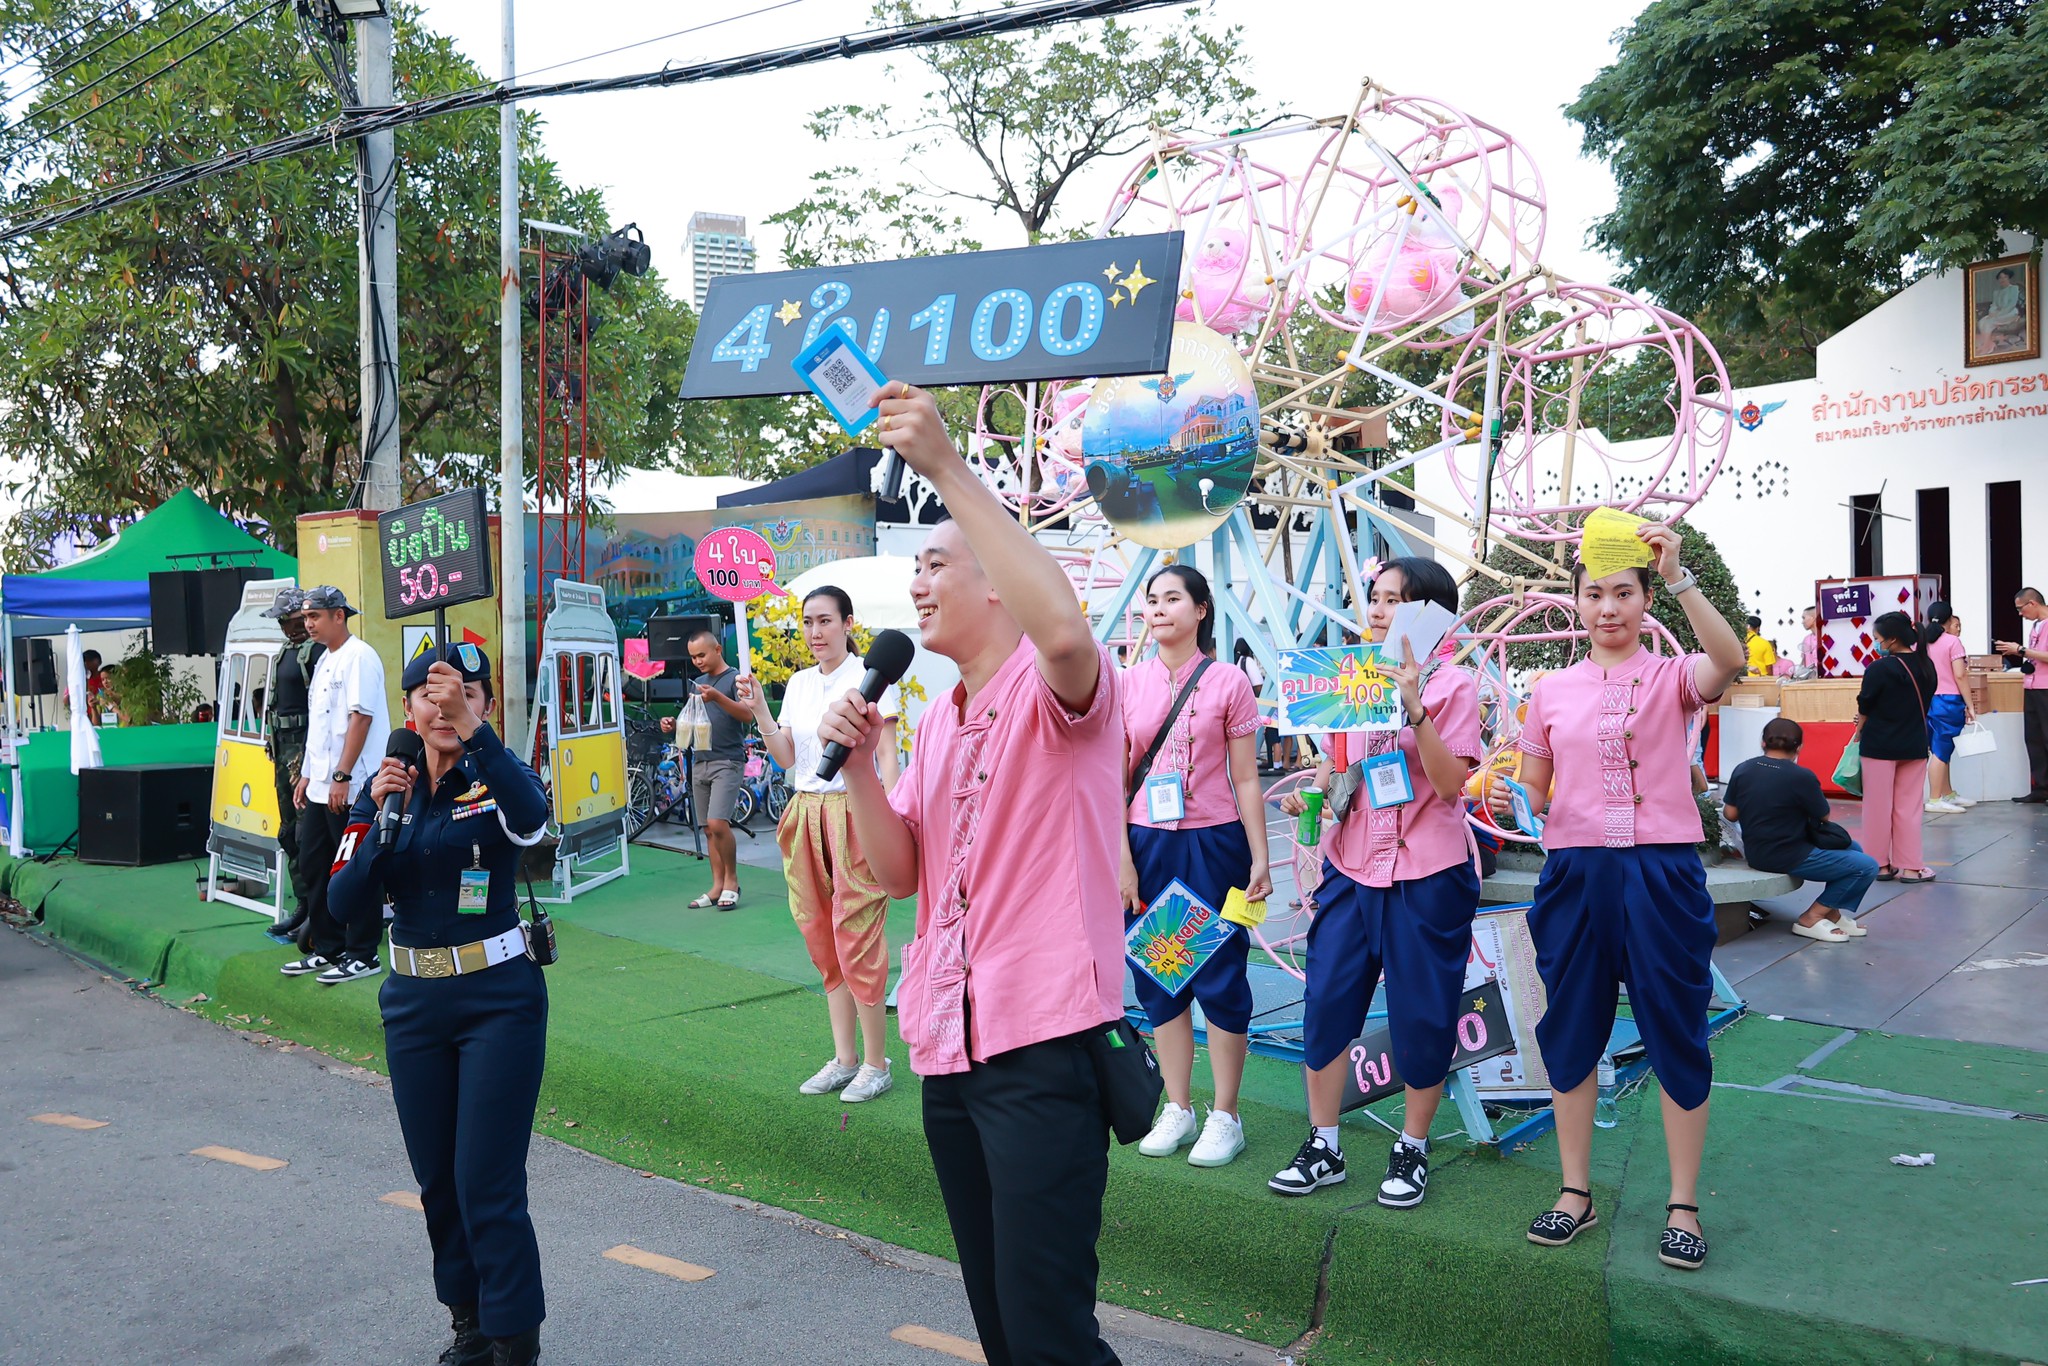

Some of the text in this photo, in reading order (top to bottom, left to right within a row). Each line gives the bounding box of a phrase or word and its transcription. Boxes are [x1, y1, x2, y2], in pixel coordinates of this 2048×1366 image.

[711, 304, 773, 373] 4
[910, 281, 1104, 366] 100
[388, 506, 470, 567] ยิงปืน
[708, 535, 757, 566] 4 ใบ
[707, 568, 762, 589] 100 บาท
[1852, 590, 1859, 599] 2
[1281, 652, 1380, 703] คูปอง 4 ใบ
[1343, 682, 1383, 705] 100
[1373, 704, 1398, 715] บาท
[1129, 941, 1147, 958] บาท
[1144, 932, 1174, 962] 100
[1161, 905, 1211, 969] คูปอง 4 ใบ
[1350, 1045, 1392, 1094] ใบ
